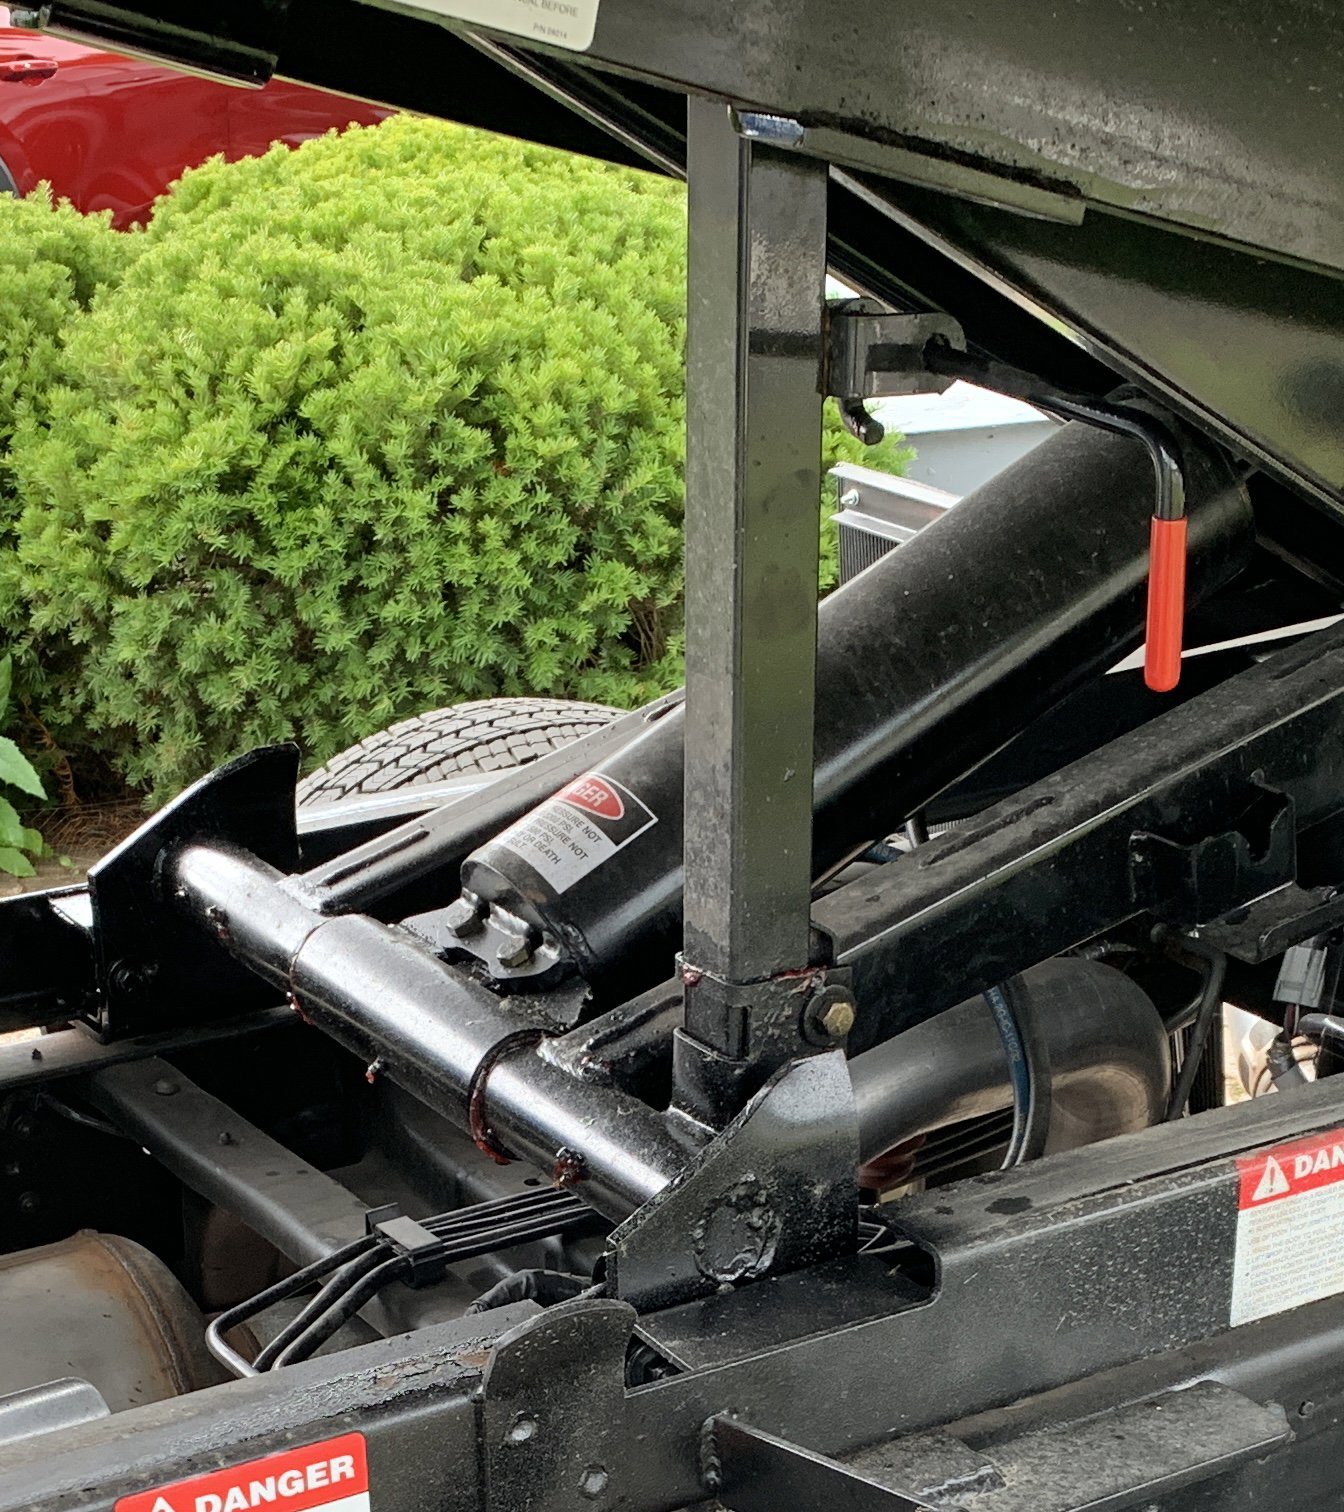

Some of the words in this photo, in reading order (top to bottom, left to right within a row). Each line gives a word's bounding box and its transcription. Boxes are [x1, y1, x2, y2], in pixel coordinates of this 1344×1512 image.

[575, 781, 609, 807] GER
[582, 825, 603, 844] NOT
[533, 839, 562, 865] DEATH
[568, 842, 589, 861] NOT
